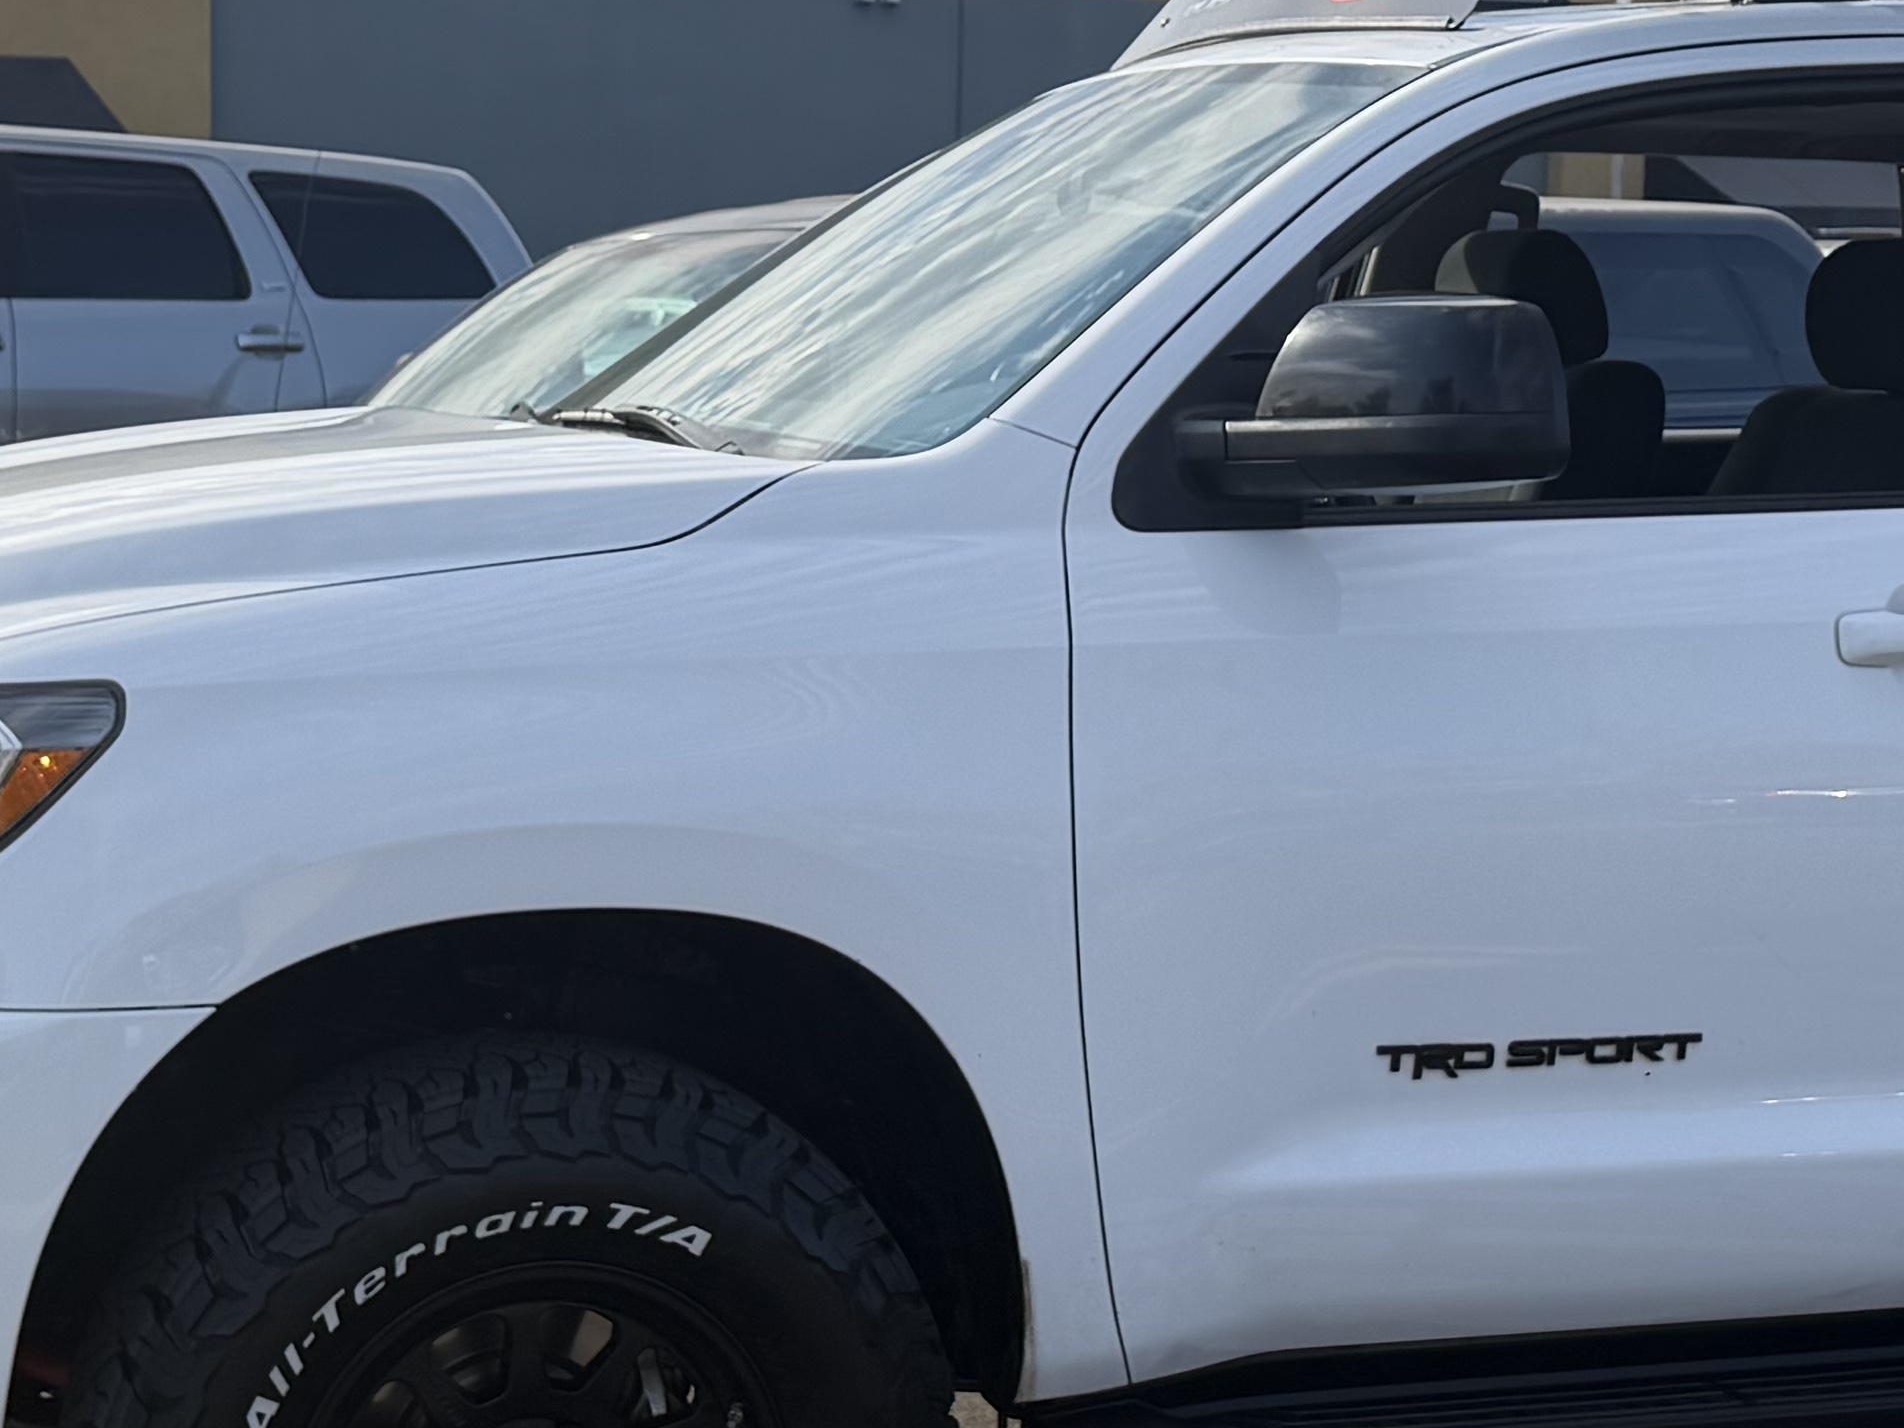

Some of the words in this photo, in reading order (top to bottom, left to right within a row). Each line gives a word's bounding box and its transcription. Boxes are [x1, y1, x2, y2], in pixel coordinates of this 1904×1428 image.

[1376, 1043, 1495, 1080] TRD
[1506, 1032, 1703, 1067] SPORT
[606, 1201, 713, 1257] T/A
